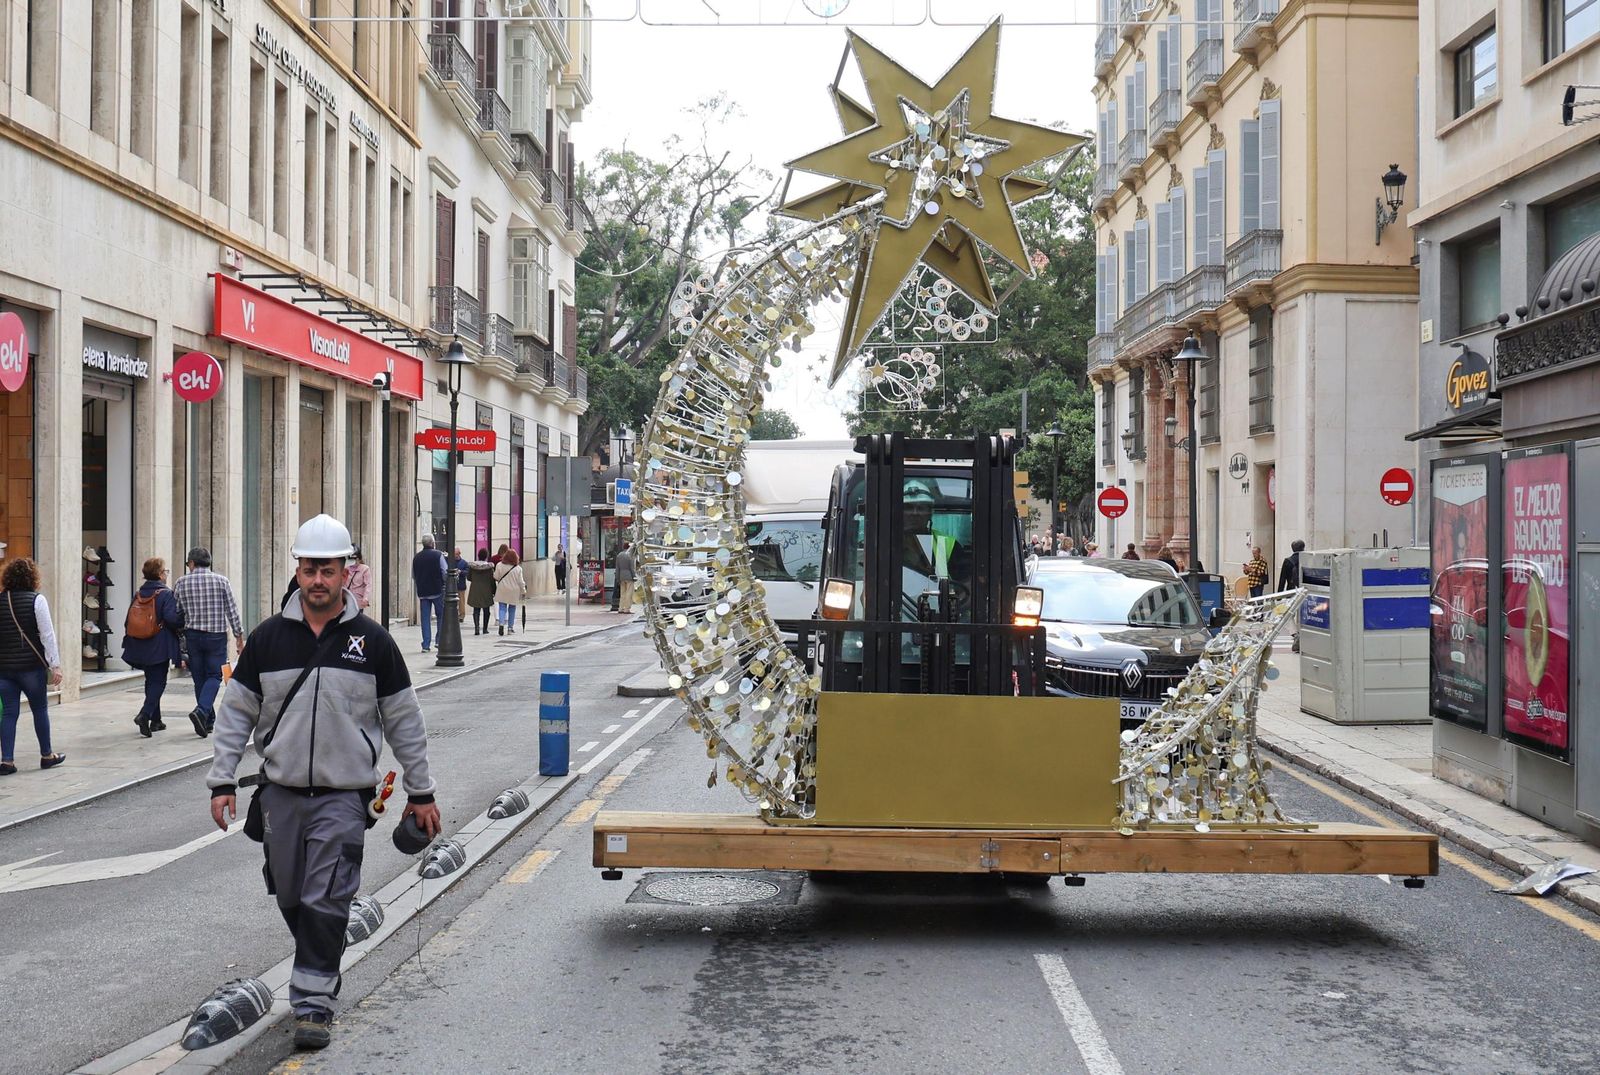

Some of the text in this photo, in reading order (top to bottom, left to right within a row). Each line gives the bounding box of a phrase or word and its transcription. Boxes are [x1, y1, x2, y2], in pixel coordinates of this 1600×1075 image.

[242, 299, 255, 333] V!
[1, 333, 24, 373] eh!
[83, 346, 149, 379] elena hernández
[179, 364, 212, 390] eh!
[1447, 361, 1488, 408] Govez
[1440, 471, 1484, 489] TICKETS HERE
[1514, 482, 1561, 517] EL MEJOR
[1514, 518, 1562, 551] AGUACATE
